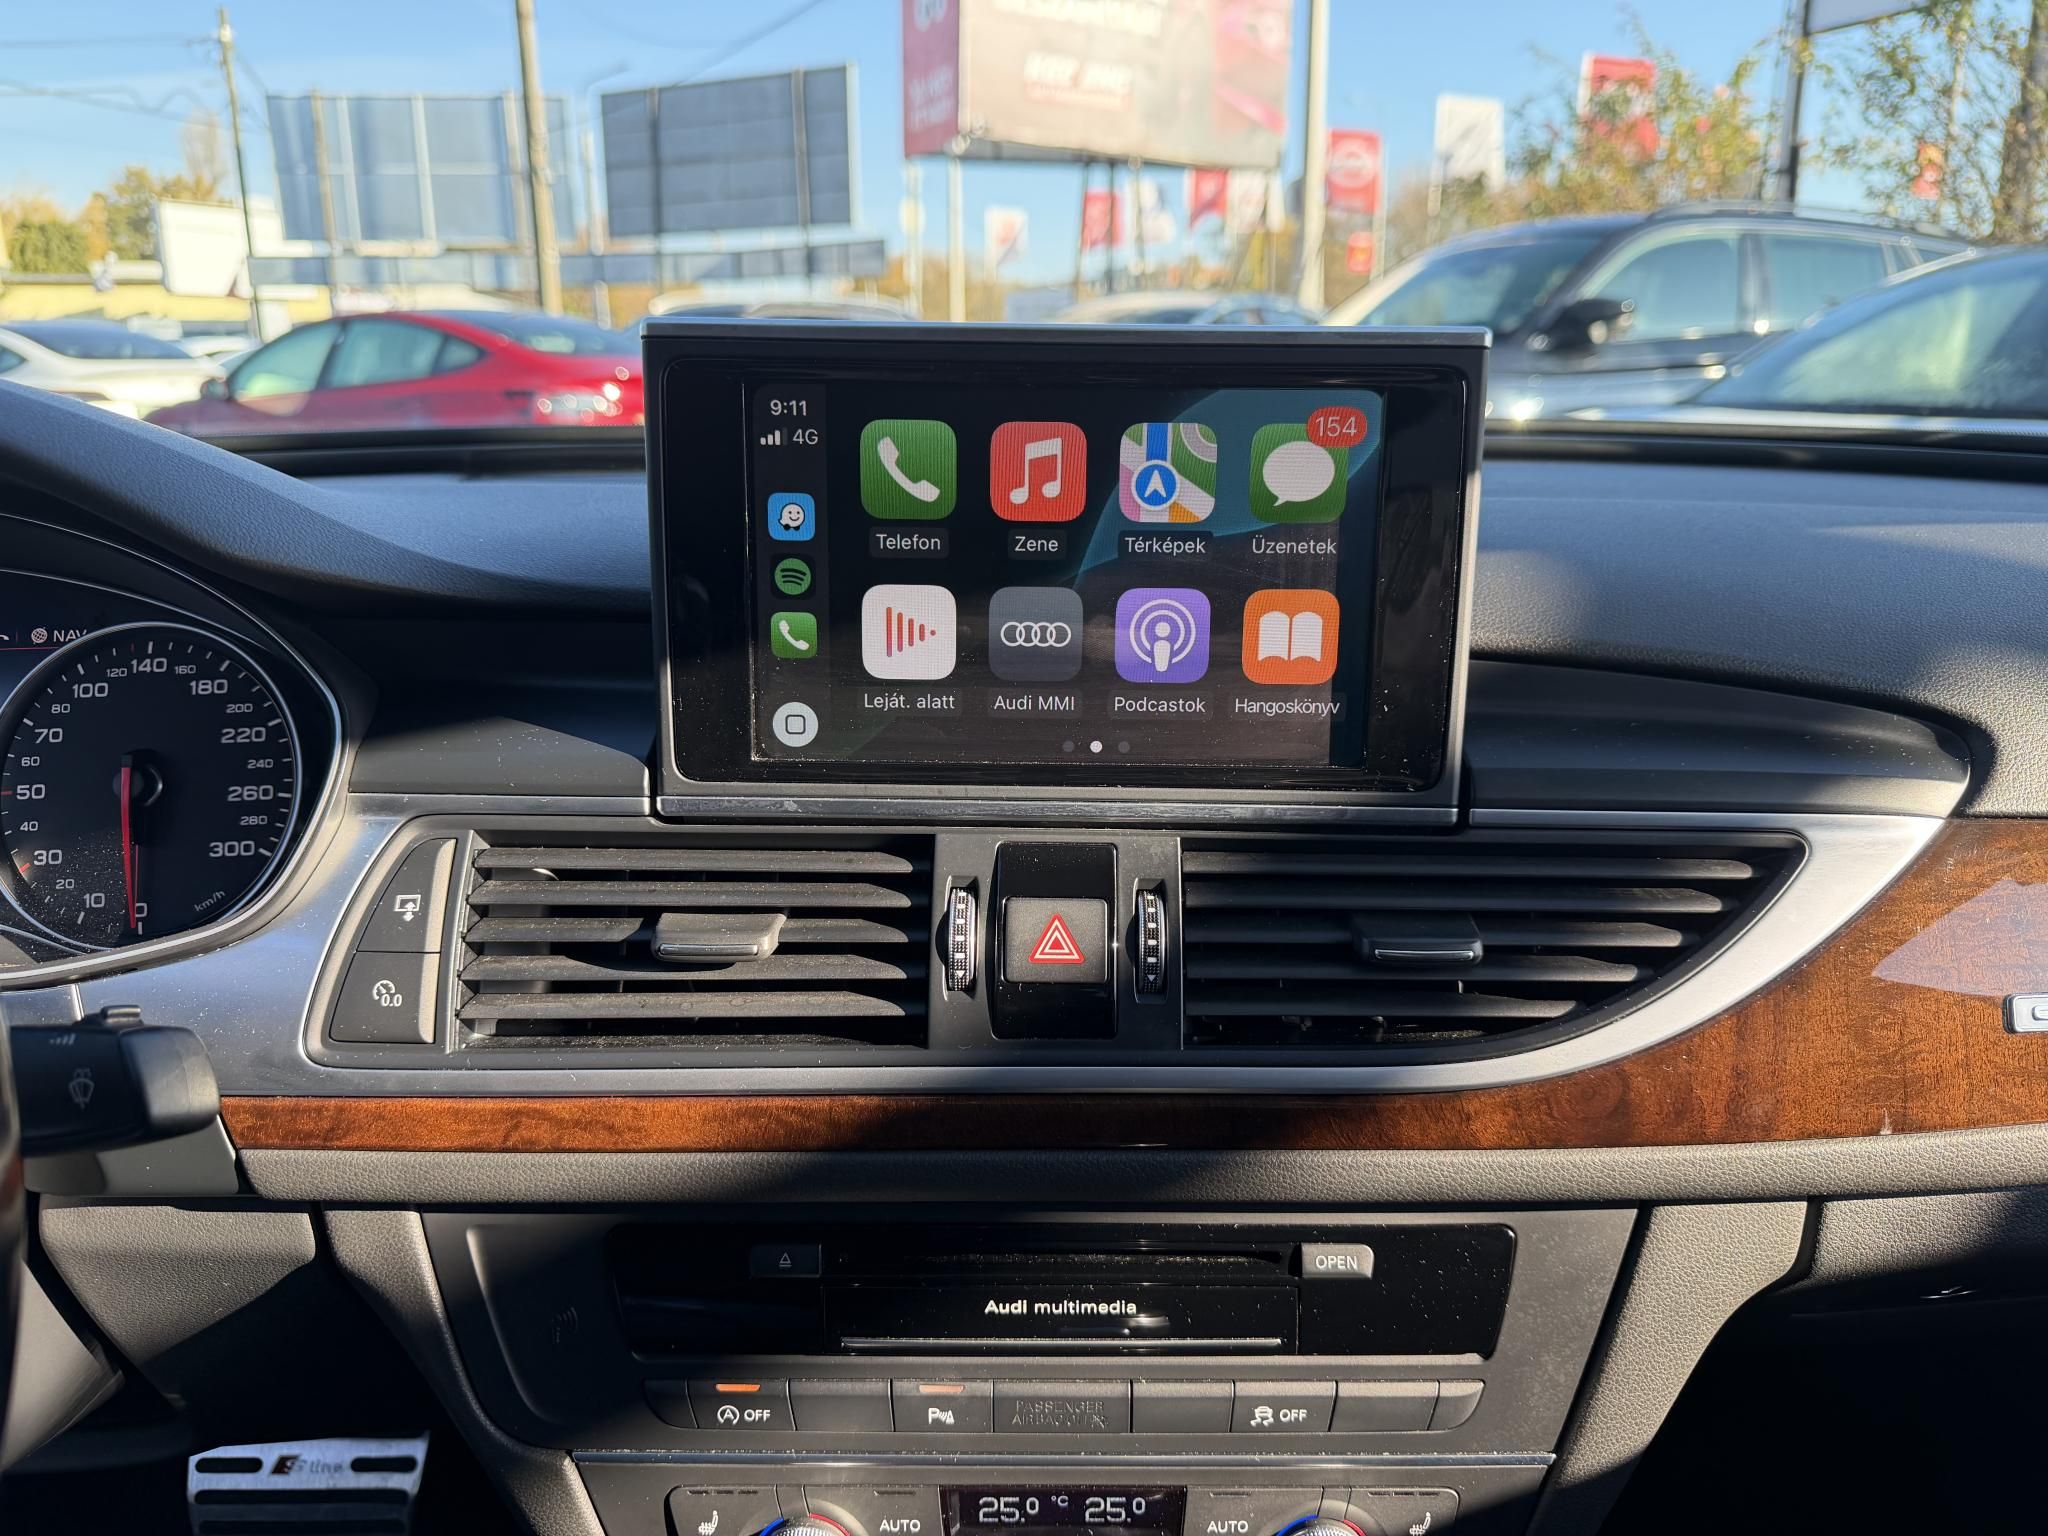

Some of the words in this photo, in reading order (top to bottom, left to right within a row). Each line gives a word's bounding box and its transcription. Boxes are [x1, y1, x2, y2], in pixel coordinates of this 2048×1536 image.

[769, 400, 808, 416] 9:11
[1315, 416, 1357, 437] 154
[792, 429, 819, 445] 4G
[876, 533, 941, 550] Telefon
[1014, 535, 1059, 552] Zene
[1125, 536, 1206, 556] Térképek
[1252, 534, 1337, 555] Üzenetek
[106, 668, 128, 678] 120
[131, 658, 168, 673] 140
[174, 664, 197, 675] 160
[72, 682, 109, 699] 100
[189, 679, 229, 696] 180
[51, 703, 71, 714] 80
[226, 703, 254, 714] 200
[864, 693, 910, 711] Leját.
[916, 693, 955, 709] alatt
[994, 695, 1032, 711] Audi
[1037, 696, 1075, 711] MMI
[1114, 696, 1206, 713] Podcastok
[1235, 698, 1340, 717] Hangoskönyv
[34, 728, 63, 744] 70
[221, 727, 267, 744] 220
[21, 756, 40, 767] 60
[247, 758, 274, 770] 240
[16, 784, 46, 801] 50
[227, 783, 274, 801] 260
[20, 821, 39, 832] 40
[240, 815, 268, 826] 280
[209, 841, 256, 858] 300
[33, 850, 63, 866] 30
[55, 878, 75, 890] 20
[84, 892, 105, 908] 10
[193, 889, 226, 912] km/h
[135, 902, 148, 918] 0
[380, 994, 402, 1007] 0.0
[1315, 1254, 1358, 1271] OPEN
[984, 1299, 1028, 1315] Audi
[1034, 1299, 1138, 1315] multimedia
[744, 1409, 771, 1422] OFF
[1279, 1409, 1307, 1423] OFF
[979, 1496, 1040, 1523] 25.0
[1085, 1496, 1146, 1523] 25.0
[879, 1518, 921, 1534] AUTO
[1206, 1520, 1249, 1534] AUTO
